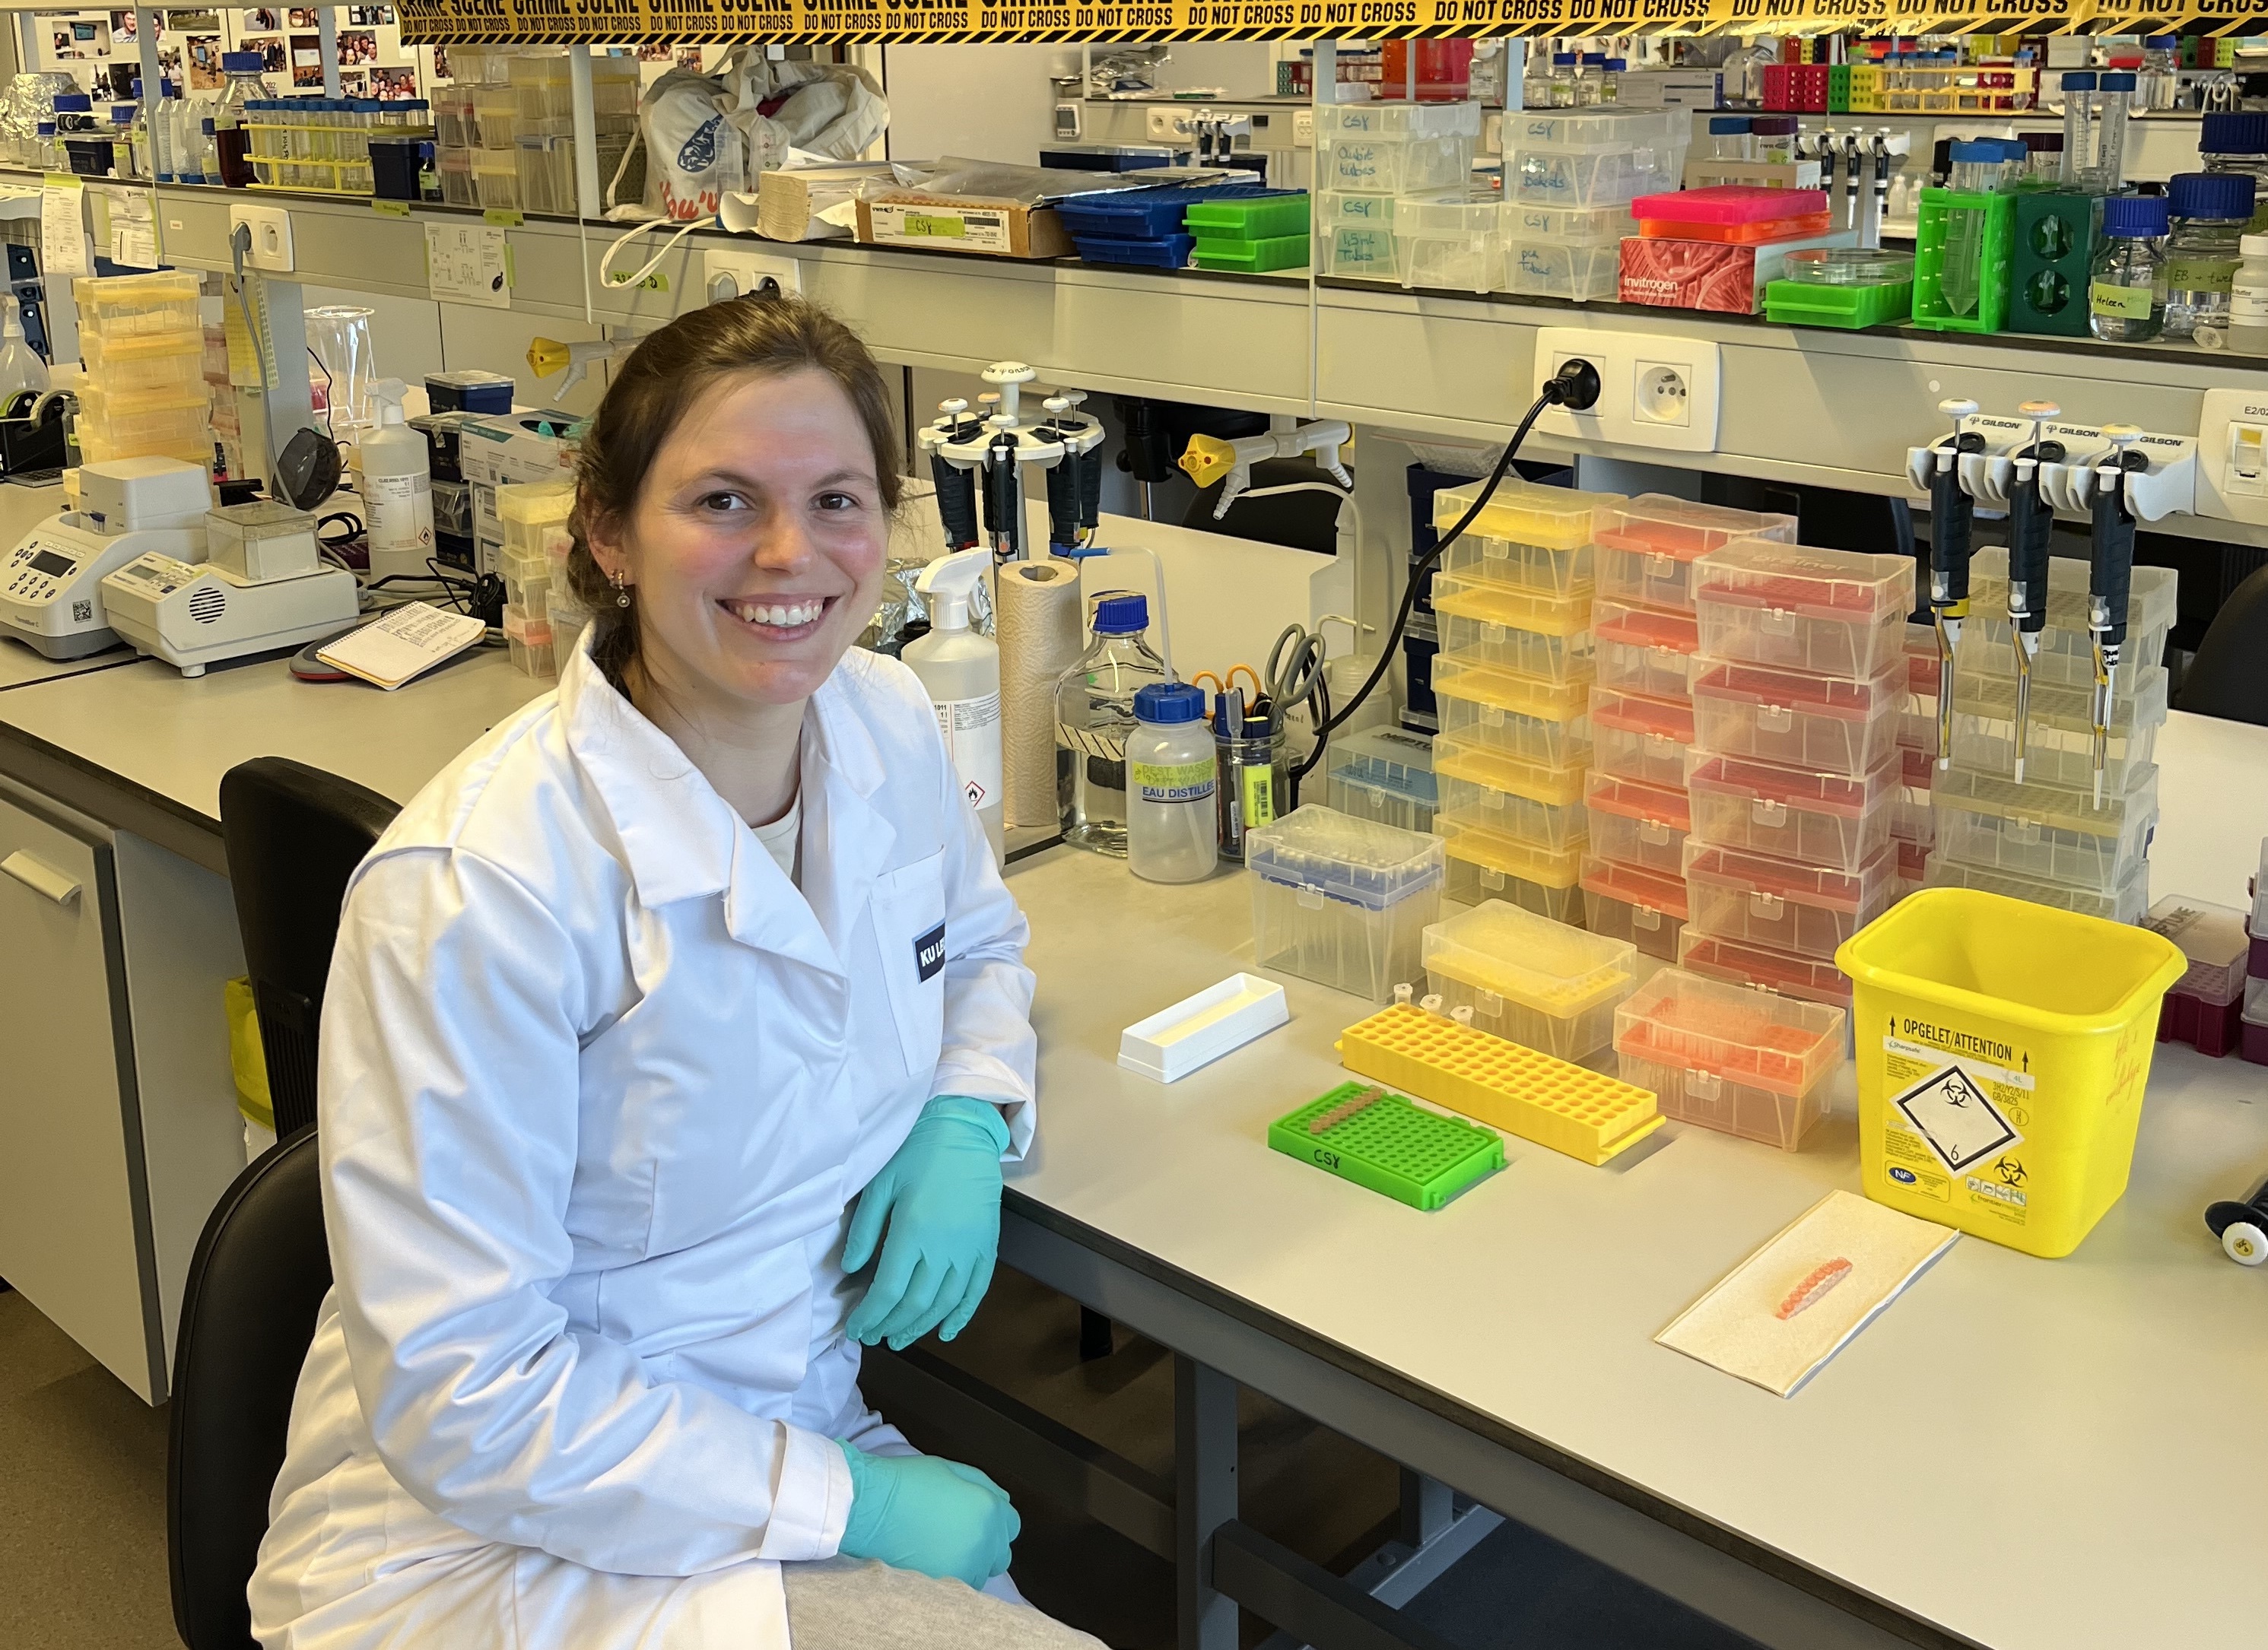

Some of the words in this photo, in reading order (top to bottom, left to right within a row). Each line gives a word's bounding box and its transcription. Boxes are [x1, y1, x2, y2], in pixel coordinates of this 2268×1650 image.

[403, 20, 413, 33] DO
[414, 19, 427, 33] NOT
[429, 18, 454, 32] CROSS
[456, 18, 467, 32] DO
[468, 17, 482, 31] NOT
[484, 17, 510, 31] CROSS
[517, 17, 529, 31] DO
[529, 17, 545, 30] NOT
[548, 17, 576, 30] CROSS
[578, 17, 590, 30] DO
[592, 17, 608, 30] NOT
[611, 17, 641, 30] CROSS
[650, 16, 663, 30] DO
[665, 16, 684, 30] NOT
[685, 15, 718, 30] CROSS
[722, 15, 735, 30] DO
[737, 15, 756, 30] NOT
[759, 14, 793, 30] CROSS
[805, 14, 818, 30] DO
[821, 14, 842, 30] NOT
[845, 13, 881, 30] CROSS
[886, 13, 901, 29] DO
[904, 13, 926, 29] NOT
[929, 12, 968, 28] CROSS
[981, 11, 997, 28] DO
[1001, 11, 1024, 27] NOT
[1028, 10, 1070, 27] CROSS
[1076, 9, 1093, 27] DO
[1097, 8, 1123, 27] NOT
[1126, 8, 1173, 26] CROSS
[1188, 7, 1207, 25] DO
[1212, 6, 1240, 24] NOT
[1244, 5, 1294, 24] CROSS
[1301, 5, 1321, 24] DO
[1326, 3, 1358, 23] NOT
[1361, 2, 1416, 22] CROSS
[1435, 1, 1458, 21] DO
[1463, 0, 1497, 21] NOT
[1501, 0, 1563, 20] CROSS
[1570, 0, 1596, 19] DO
[1600, 0, 1640, 18] NOT
[1643, 0, 1710, 17] CROSS
[1733, 0, 1761, 17] DO
[1765, 0, 1808, 17] NOT
[1813, 0, 1886, 16] CROSS
[1896, 0, 1927, 14] DO
[1933, 0, 1980, 14] NOT
[1986, 0, 2069, 13] CROSS
[2174, 269, 2189, 282] EB
[1624, 274, 1679, 293] invitrogen
[1981, 419, 2020, 429] GILSON
[2059, 427, 2099, 439] GILSON
[2139, 436, 2181, 446] GILSON
[1142, 785, 1165, 797] EAU
[920, 944, 936, 967] KU
[1904, 1018, 2012, 1061] OPGELET/ATTENTION
[1950, 1144, 1959, 1161] 6
[1895, 1169, 1911, 1179] NF
